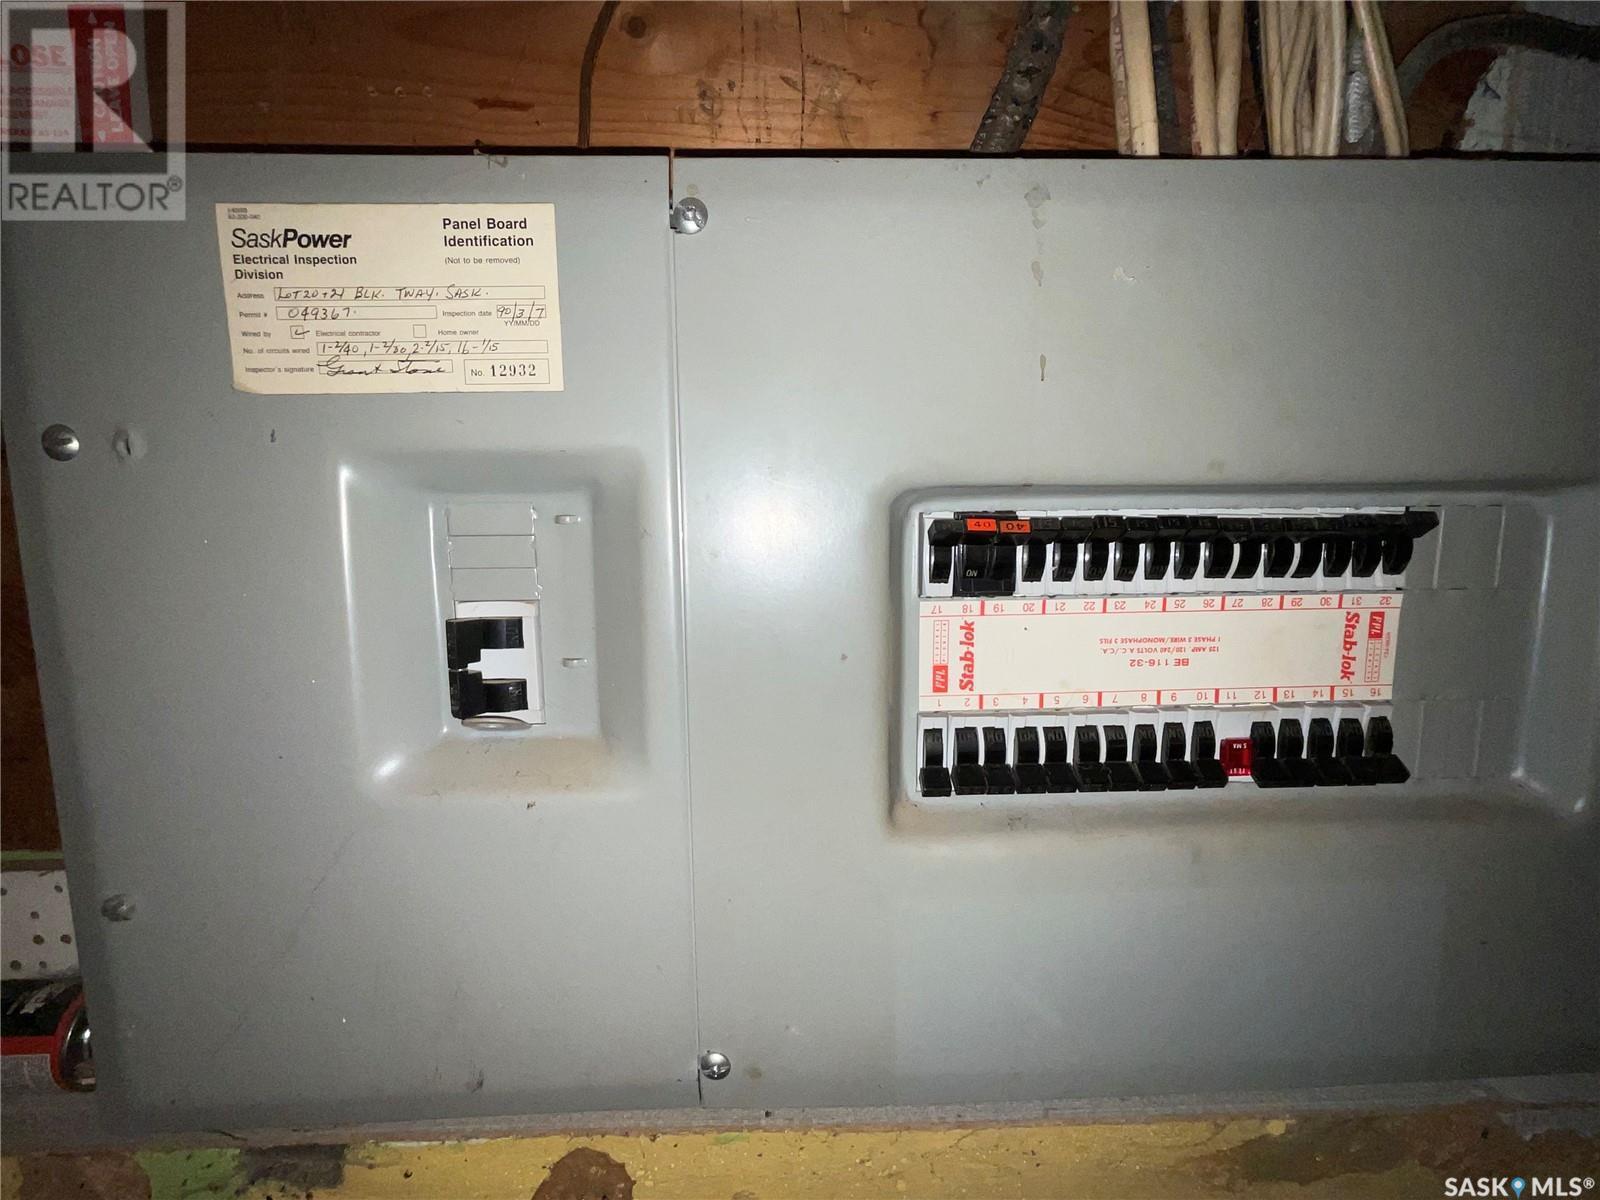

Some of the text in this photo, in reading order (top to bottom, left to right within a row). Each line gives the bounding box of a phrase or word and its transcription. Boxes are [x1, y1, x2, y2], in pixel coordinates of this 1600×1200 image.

[442, 218, 528, 230] Panel Board
[231, 228, 352, 249] SaskPower
[443, 235, 534, 247] Identification
[233, 254, 358, 267] Electrical Inspection
[444, 256, 521, 265] (Not to be removed)
[234, 269, 284, 280] Division
[442, 310, 476, 318] Inspection
[241, 330, 261, 338] Wired
[470, 363, 537, 377] No. 12932
[931, 596, 1392, 614] 17 18 19 20 21 22 23 24 25 26 27 28 29 30 31 32
[1340, 611, 1361, 681] Stab-lok
[958, 619, 975, 691] Stab-lok
[1174, 658, 1190, 667] BE
[937, 688, 1381, 707] 1 2 3 4 5 6 7 8 9 10 11 12 13 14 15 16
